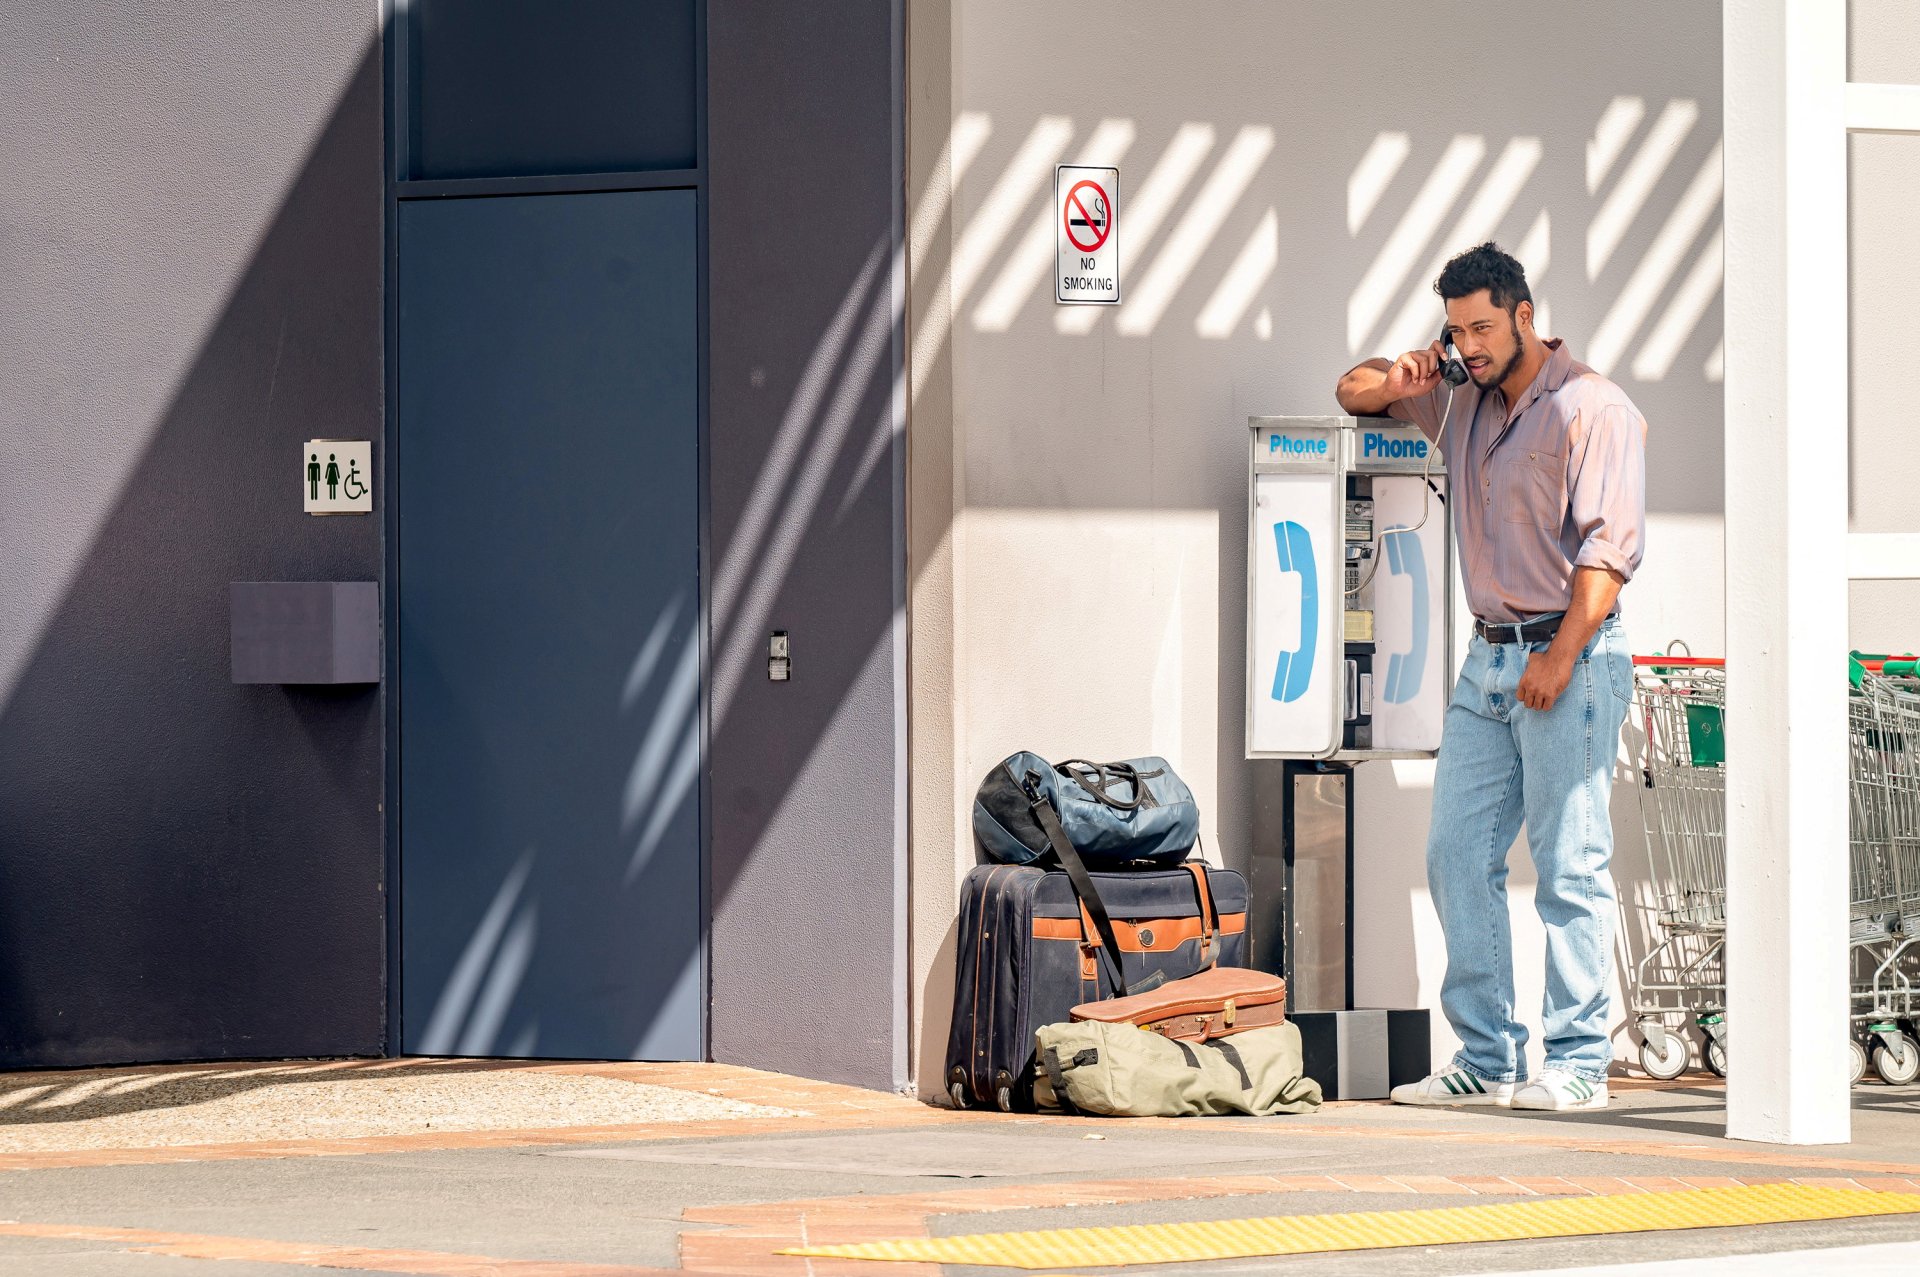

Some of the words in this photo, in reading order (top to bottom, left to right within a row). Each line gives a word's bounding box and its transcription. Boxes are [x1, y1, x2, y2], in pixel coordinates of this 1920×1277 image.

[1080, 257, 1096, 270] NO
[1063, 276, 1113, 291] SMOKING
[1270, 434, 1328, 454] Phone
[1364, 433, 1428, 458] Phone
